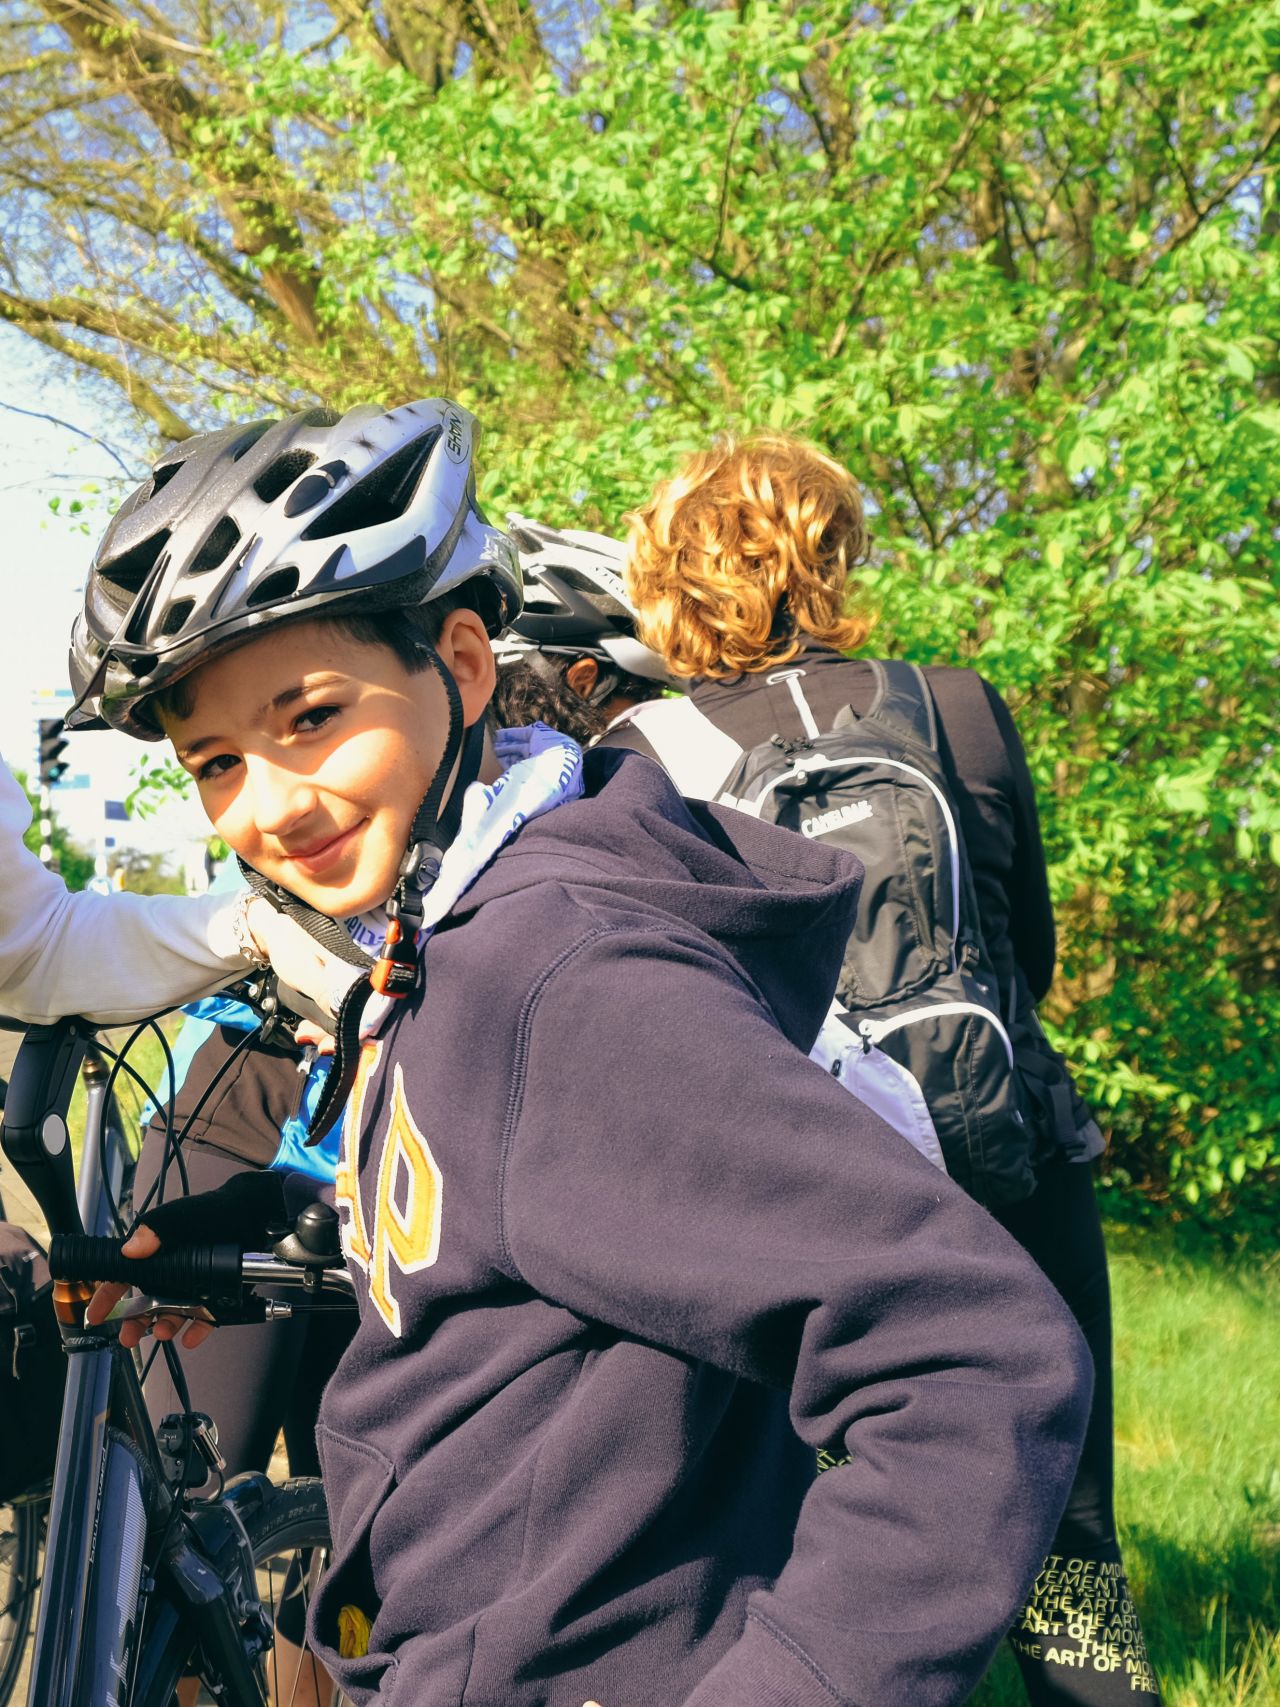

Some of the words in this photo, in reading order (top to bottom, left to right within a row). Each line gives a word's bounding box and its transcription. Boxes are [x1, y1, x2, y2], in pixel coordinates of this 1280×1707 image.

[1066, 1558, 1097, 1574] OF
[1030, 1595, 1074, 1611] THE
[1077, 1598, 1118, 1613] ART
[1064, 1610, 1106, 1627] THE
[1110, 1613, 1138, 1629] ART
[1021, 1619, 1064, 1636] ART
[1067, 1622, 1099, 1640] OF
[1078, 1638, 1121, 1658] THE
[1044, 1647, 1090, 1669] ART
[1093, 1655, 1121, 1672] OF
